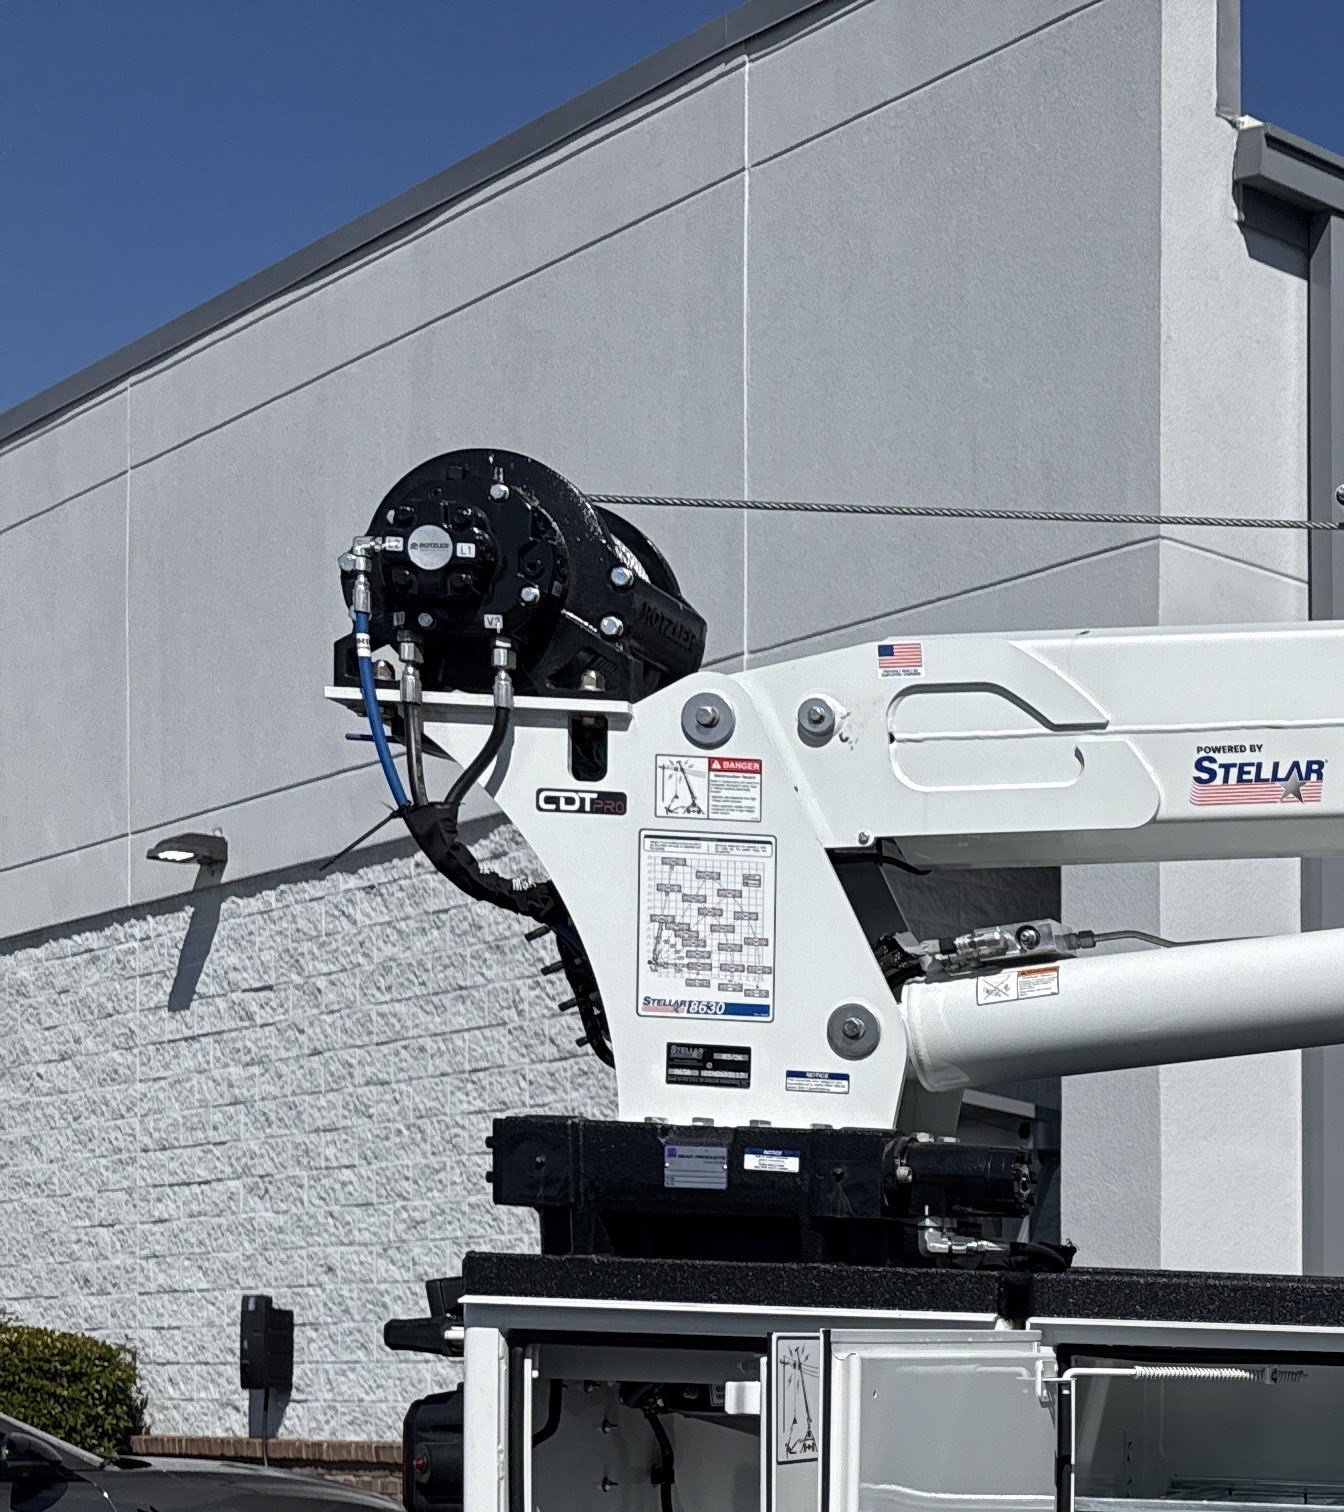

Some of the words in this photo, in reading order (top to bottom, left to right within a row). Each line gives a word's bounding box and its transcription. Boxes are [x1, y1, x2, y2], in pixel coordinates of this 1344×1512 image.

[460, 547, 473, 556] L1
[1196, 744, 1247, 755] POWERED
[1249, 743, 1264, 754] BY
[722, 760, 760, 770] DANGER
[1192, 755, 1325, 786] STELLAR
[689, 1001, 726, 1014] 8630
